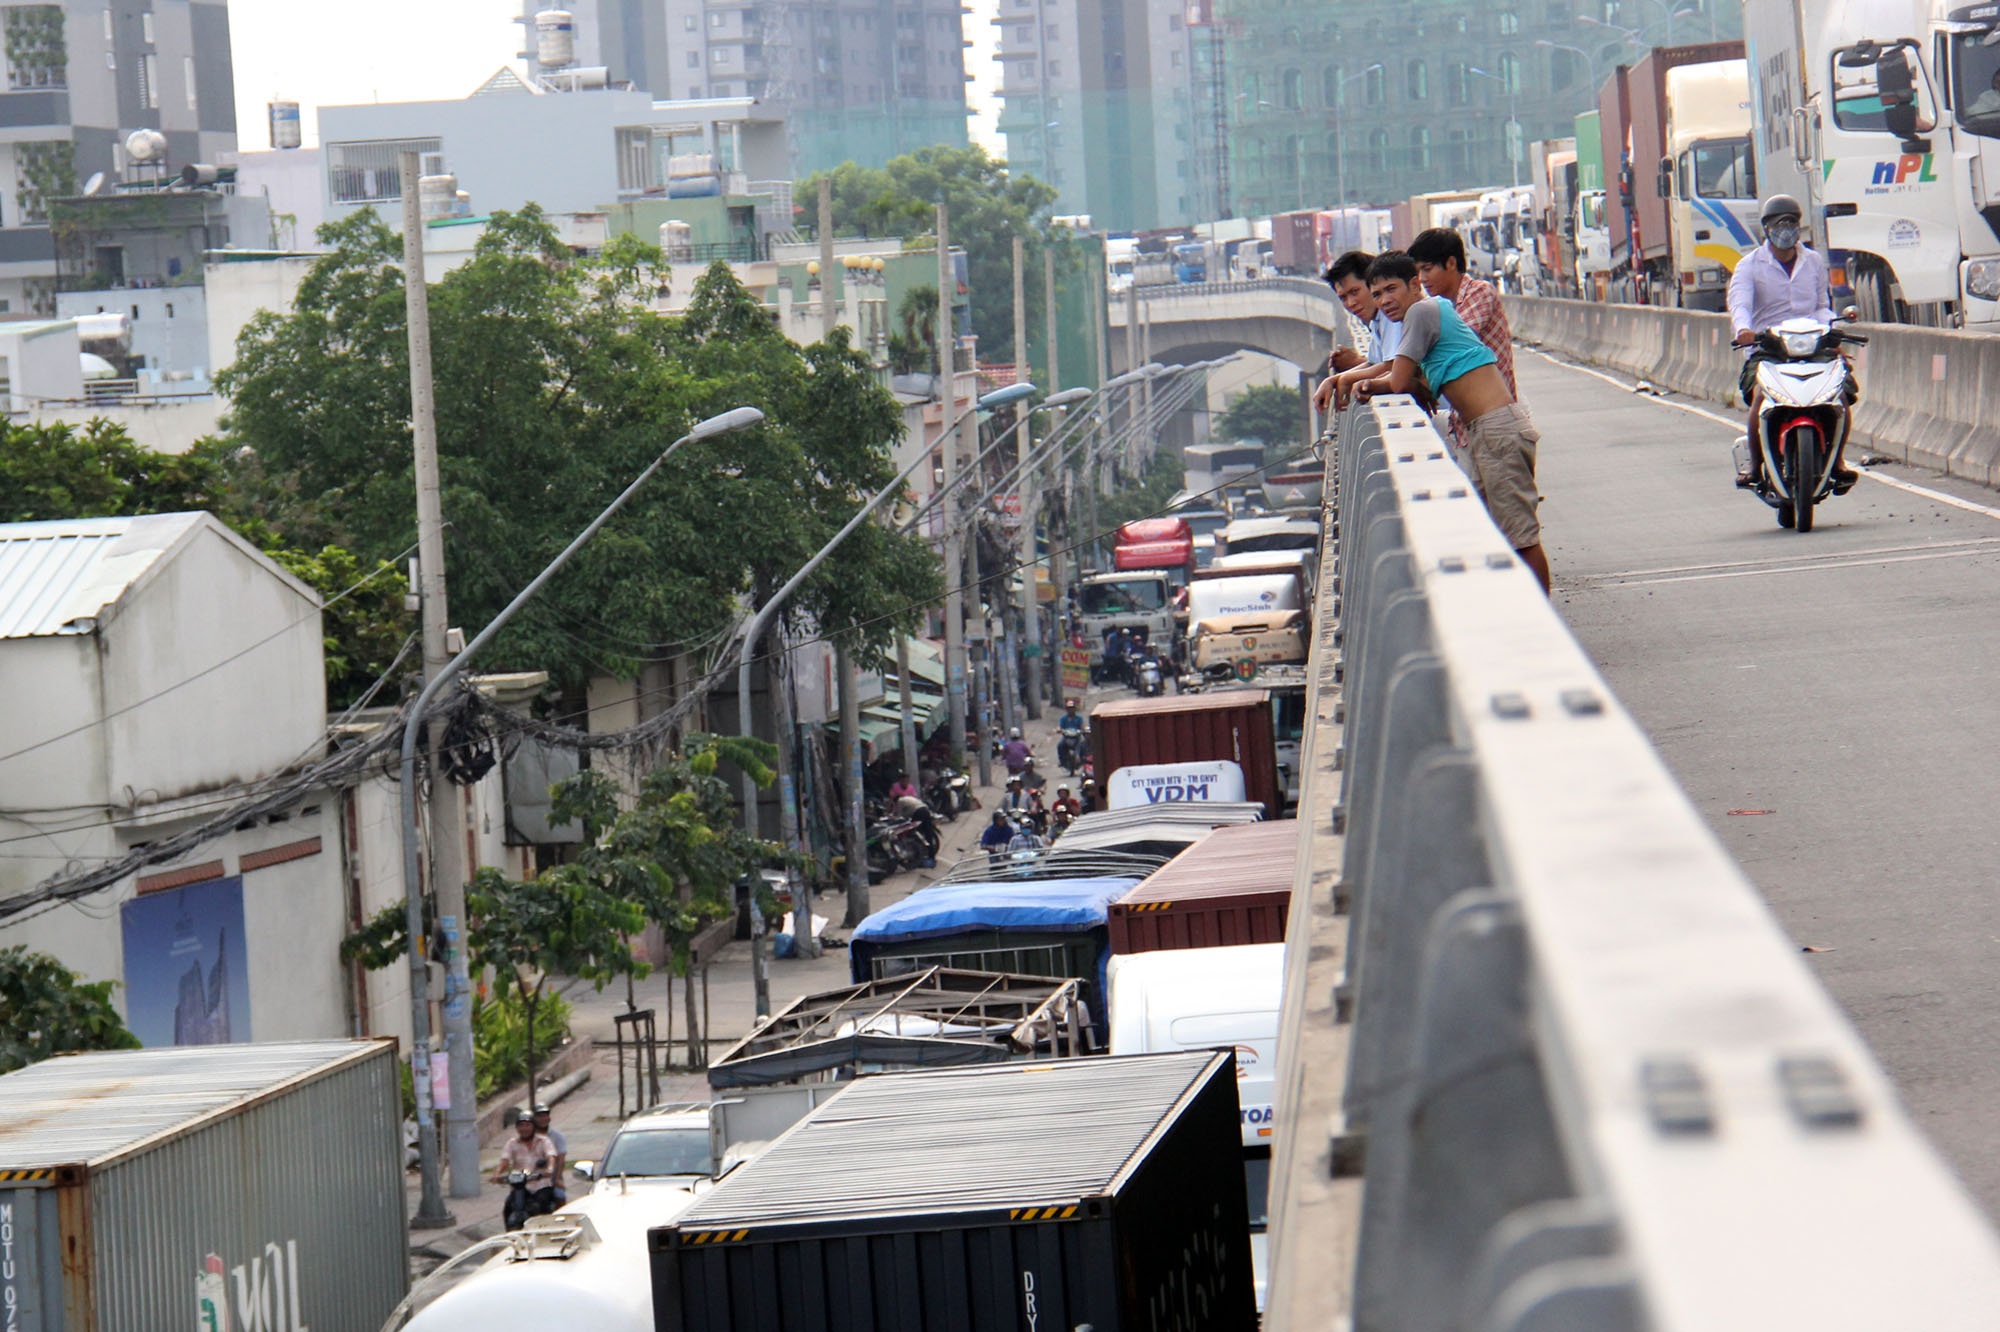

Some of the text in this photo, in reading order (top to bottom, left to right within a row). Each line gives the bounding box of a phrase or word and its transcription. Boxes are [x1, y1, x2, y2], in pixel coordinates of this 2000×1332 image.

[1871, 152, 1938, 185] nPL
[1145, 783, 1209, 805] VDM
[0, 1203, 15, 1280] MOTU
[1023, 1270, 1038, 1332] DRY
